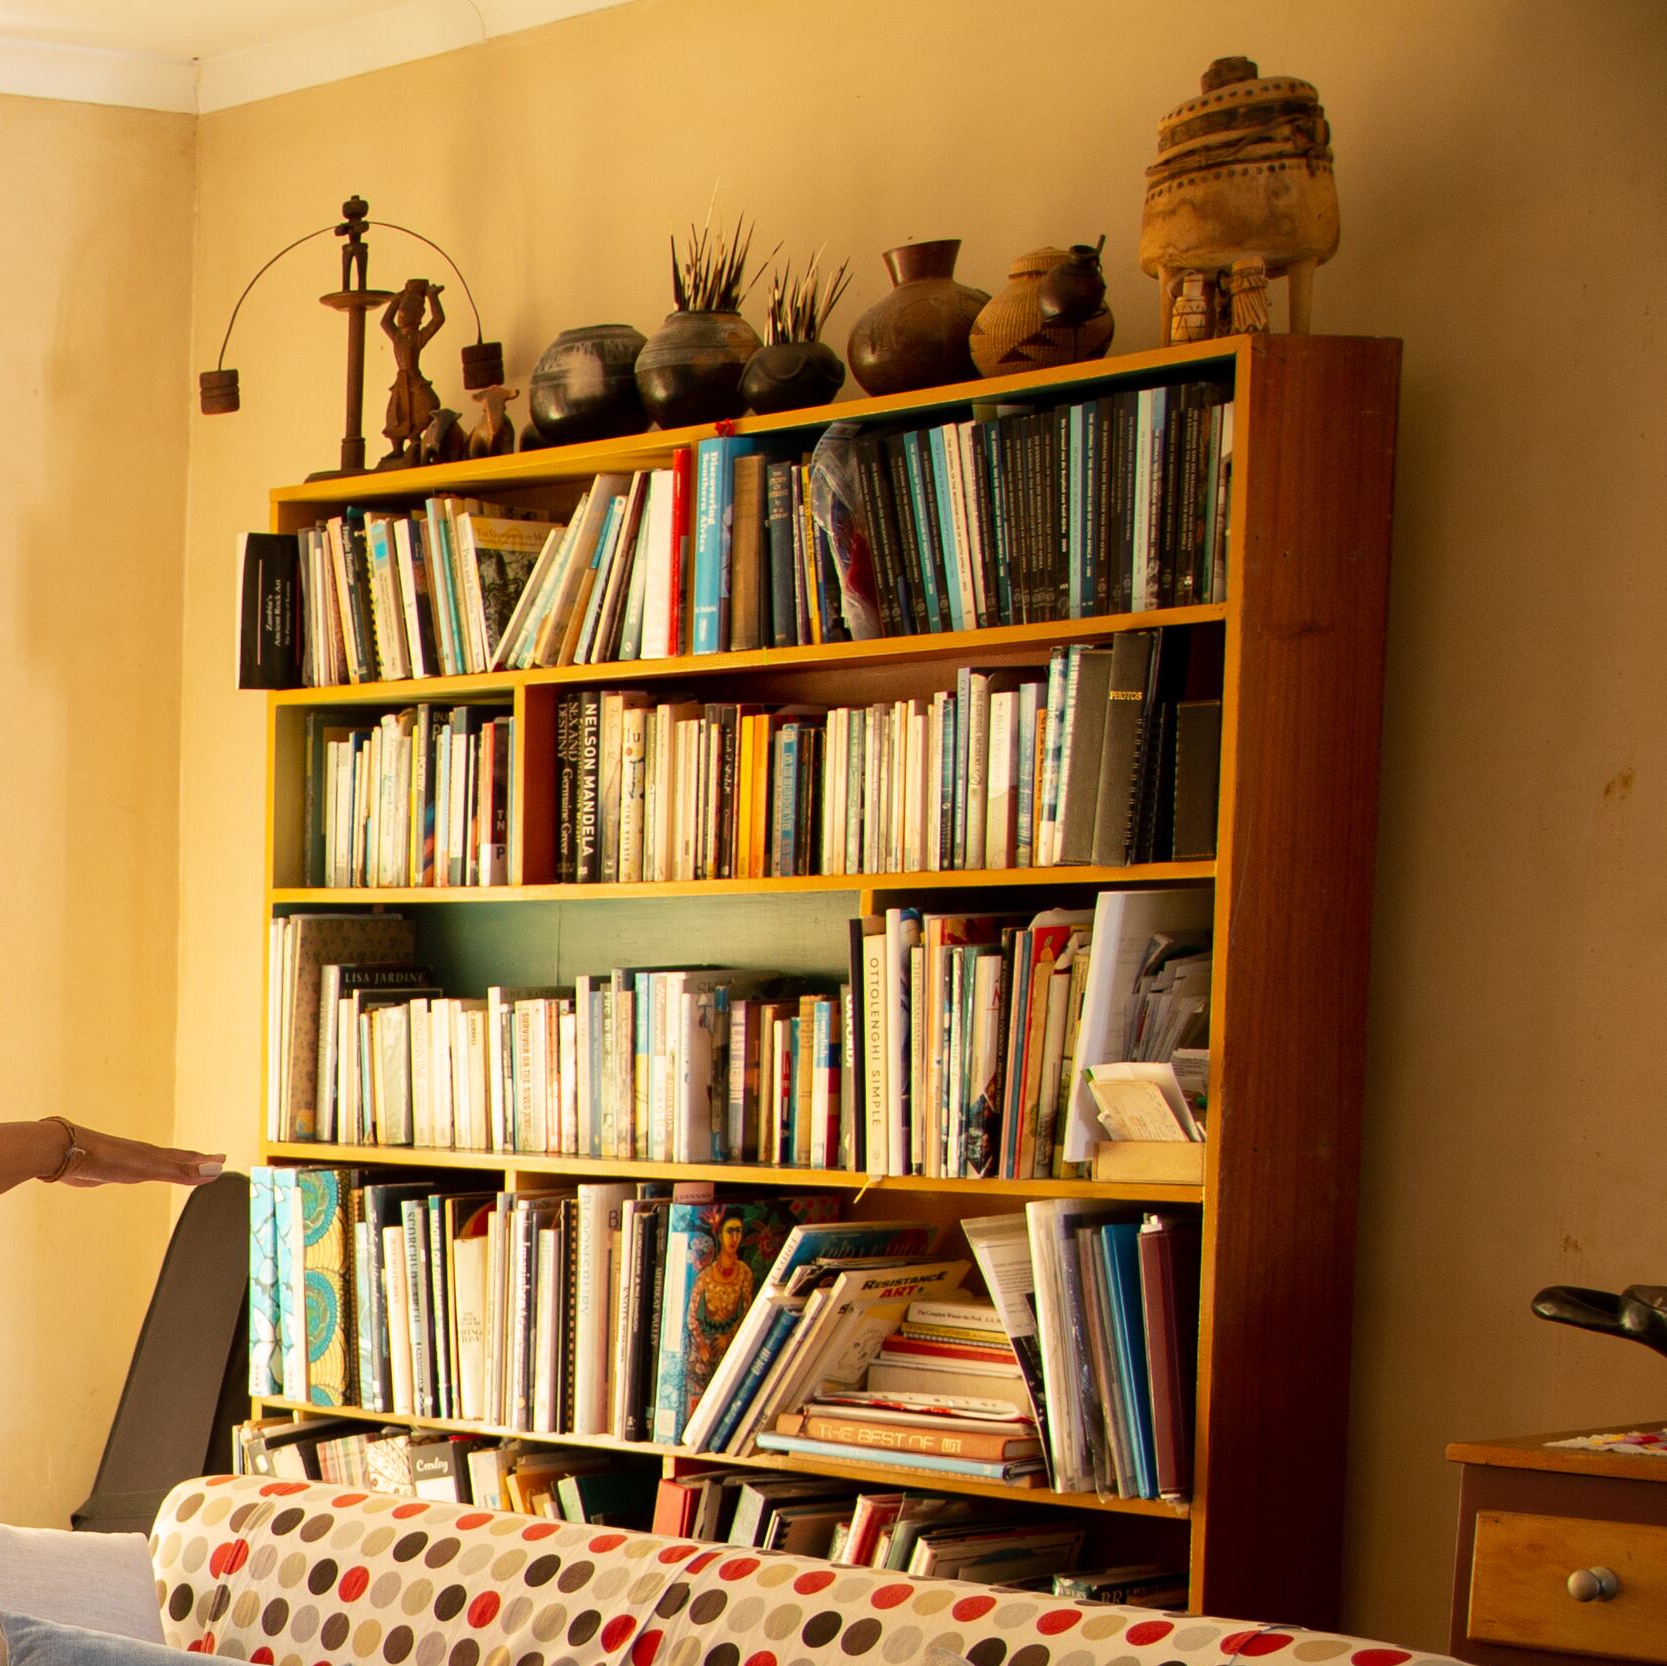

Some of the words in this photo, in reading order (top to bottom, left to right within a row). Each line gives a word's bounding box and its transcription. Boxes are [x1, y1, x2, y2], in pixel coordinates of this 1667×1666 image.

[701, 452, 710, 509] Southern
[708, 452, 718, 525] Discovering
[699, 513, 707, 553] Africa
[568, 702, 579, 725] SEX
[1109, 690, 1143, 701] PHOTOS
[557, 703, 568, 759] DESTINY
[568, 729, 579, 761] AND
[584, 703, 597, 769] NELSON
[561, 768, 573, 822] Germaine
[582, 776, 596, 857] MANDELA
[560, 823, 572, 855] Greer
[345, 972, 370, 983] LISA
[374, 972, 425, 985] JARDINE
[869, 957, 880, 1061] OTTOLENGHI
[522, 1012, 530, 1054] SURVIVOR
[871, 1070, 881, 1127] SIMPLE
[579, 1195, 591, 1317] BLOOMSBURY
[860, 1271, 948, 1291] RESISTANCE
[879, 1284, 920, 1299] ART
[818, 1423, 853, 1441] THE
[857, 1428, 906, 1445] BEST
[908, 1434, 935, 1451] OF
